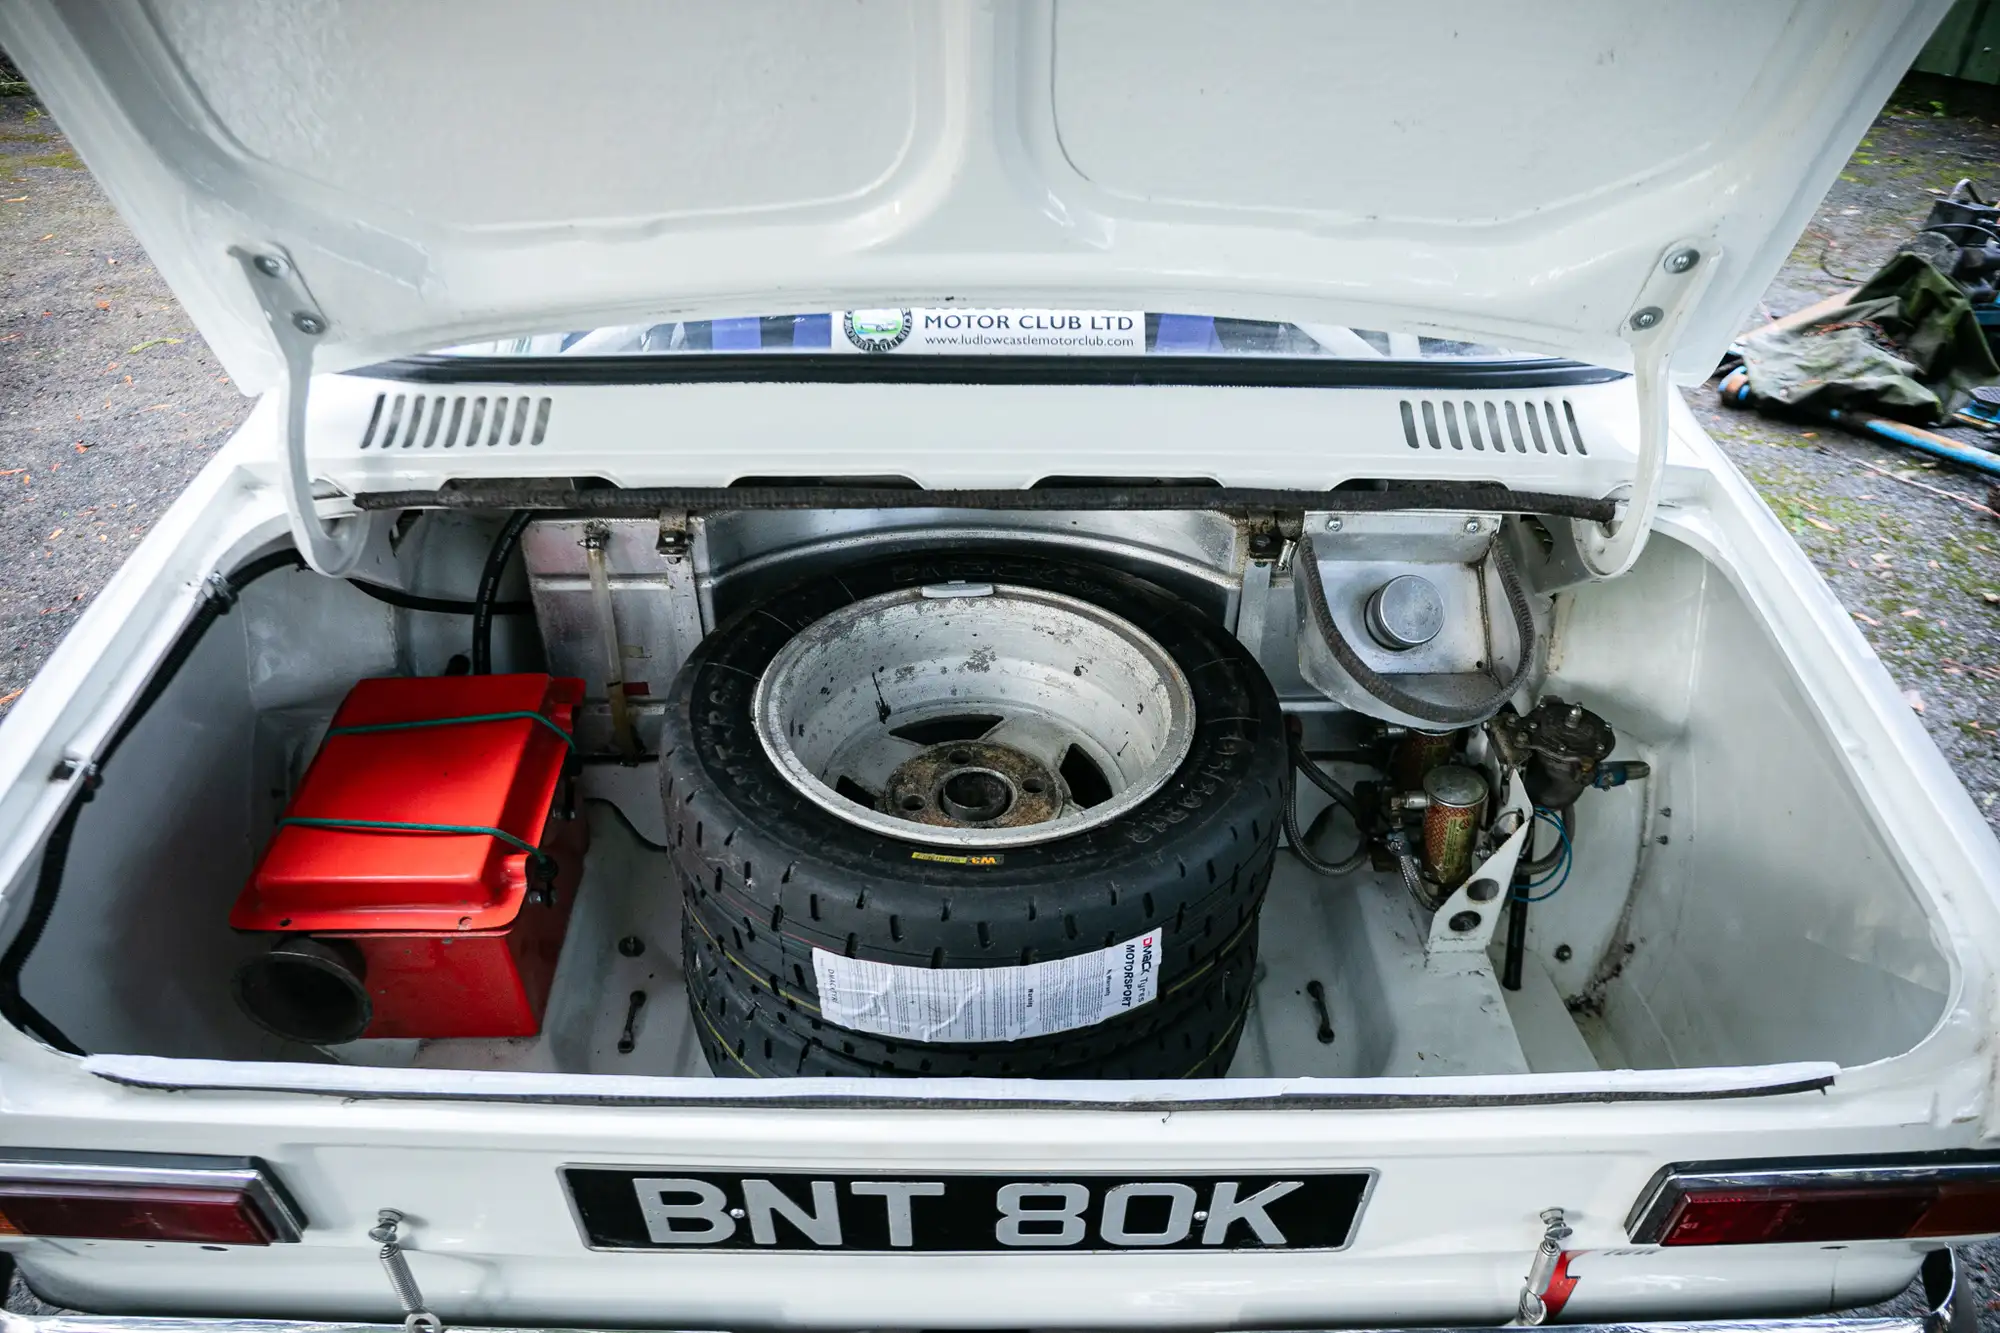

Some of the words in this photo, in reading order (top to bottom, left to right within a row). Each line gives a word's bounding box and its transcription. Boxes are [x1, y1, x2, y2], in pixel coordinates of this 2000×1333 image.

[924, 315, 1010, 329] MOTOR
[1018, 315, 1082, 330] CLUB
[1090, 316, 1134, 331] LTD
[925, 334, 1134, 347] www.ludlowcastlemotorclub.com
[1121, 944, 1136, 1008] MOTORSPORT
[632, 1178, 945, 1247] BNT
[996, 1181, 1306, 1246] 80K
